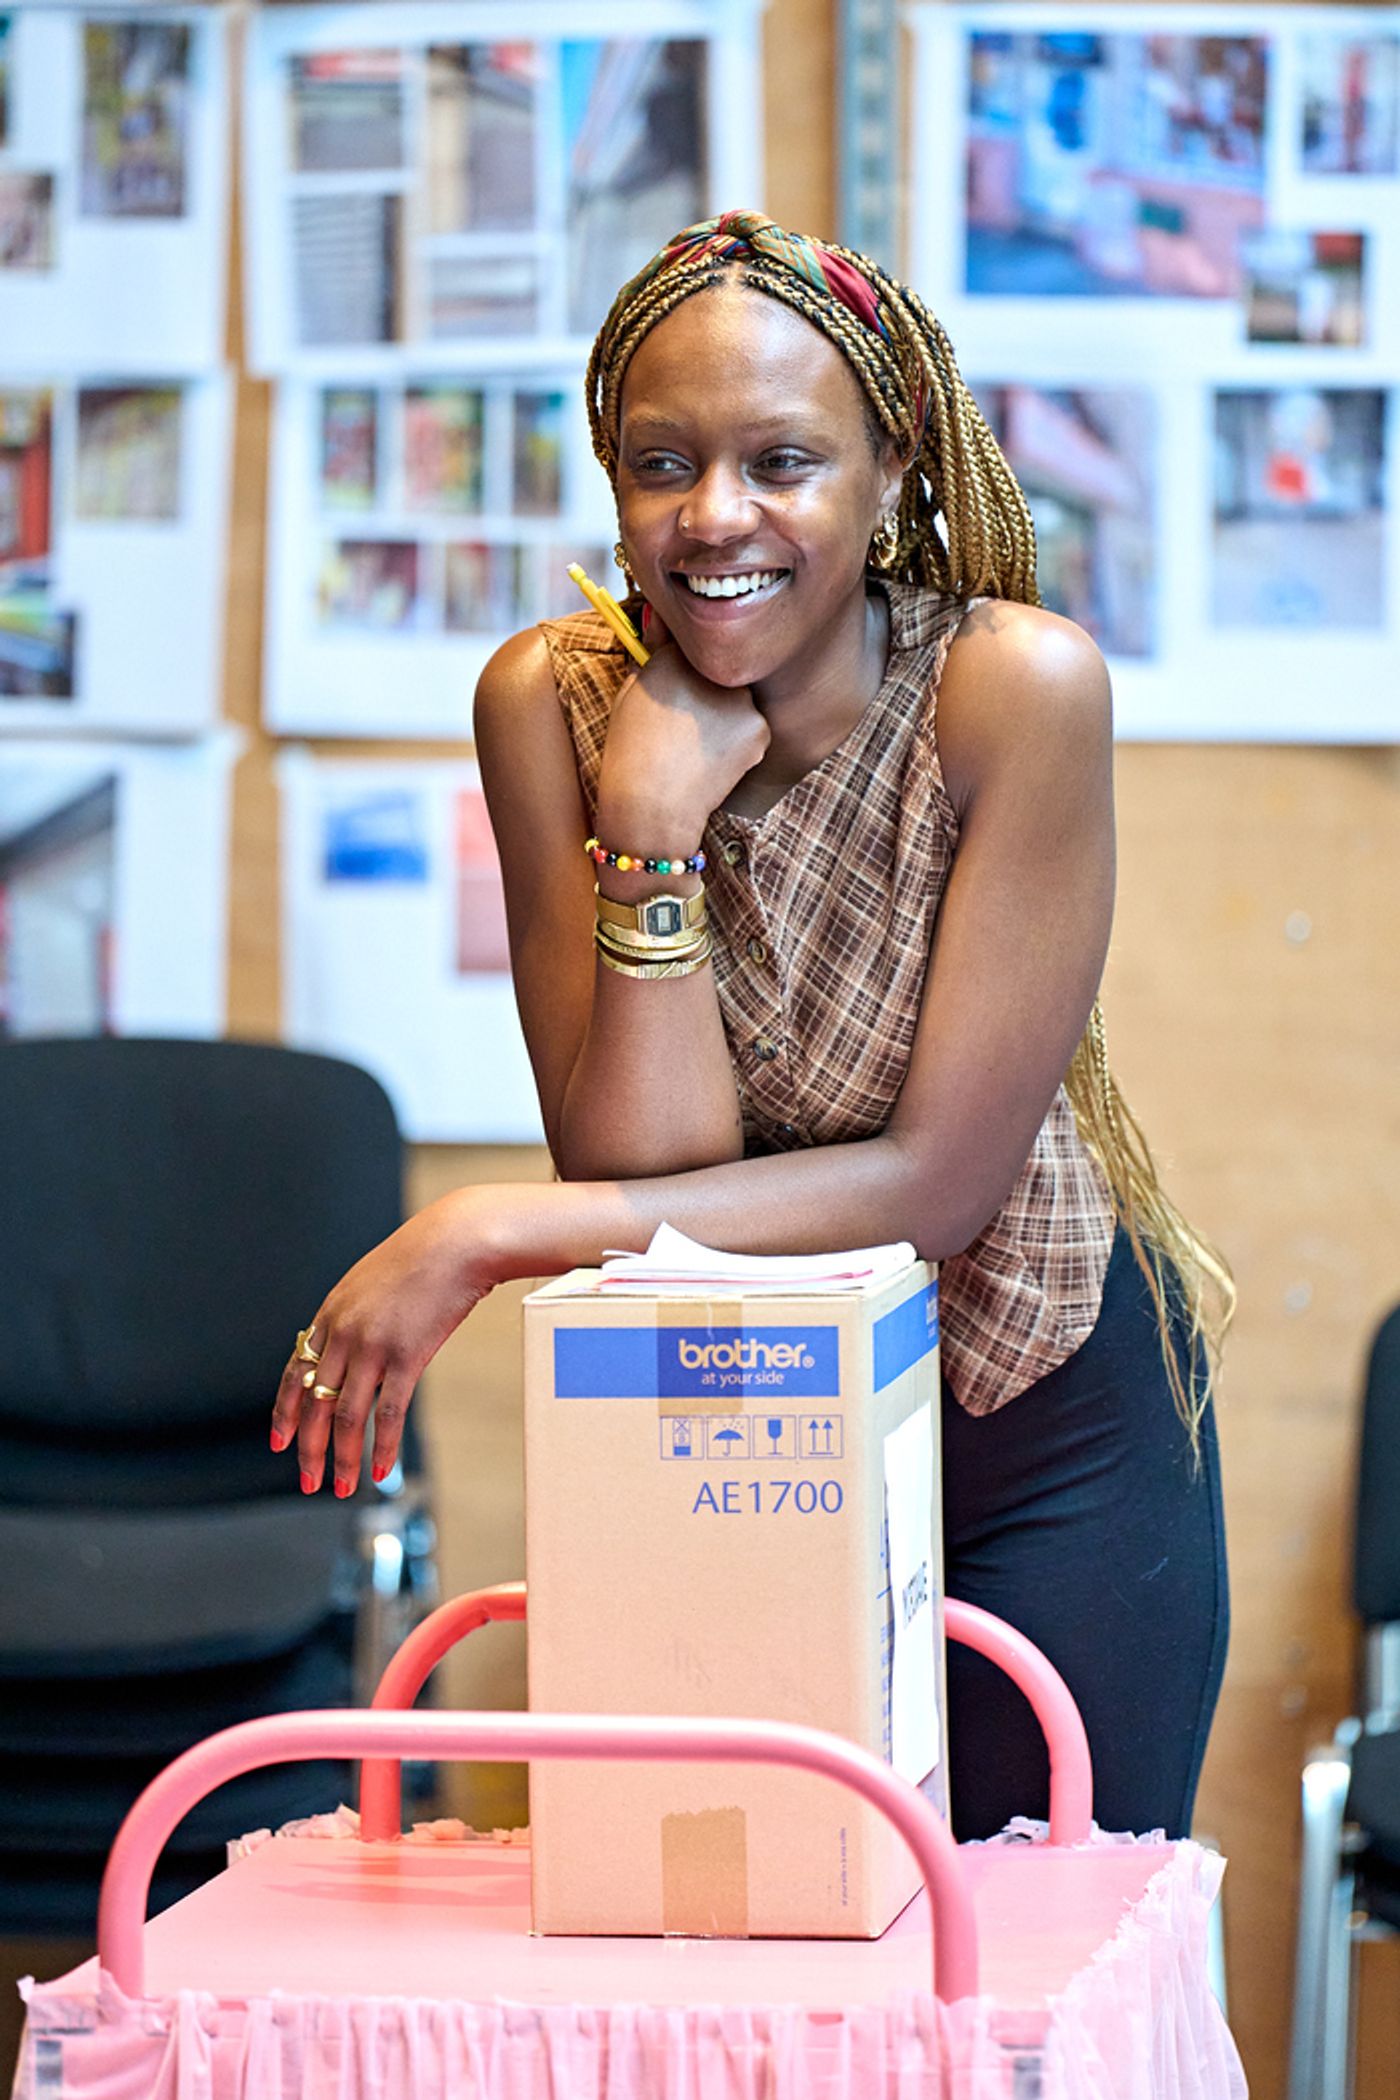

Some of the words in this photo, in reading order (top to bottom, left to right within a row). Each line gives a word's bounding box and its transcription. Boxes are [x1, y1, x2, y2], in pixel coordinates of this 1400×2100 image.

[702, 1372, 716, 1385] at
[719, 1373, 752, 1388] your
[755, 1370, 785, 1385] side
[692, 1480, 843, 1514] AE1700
